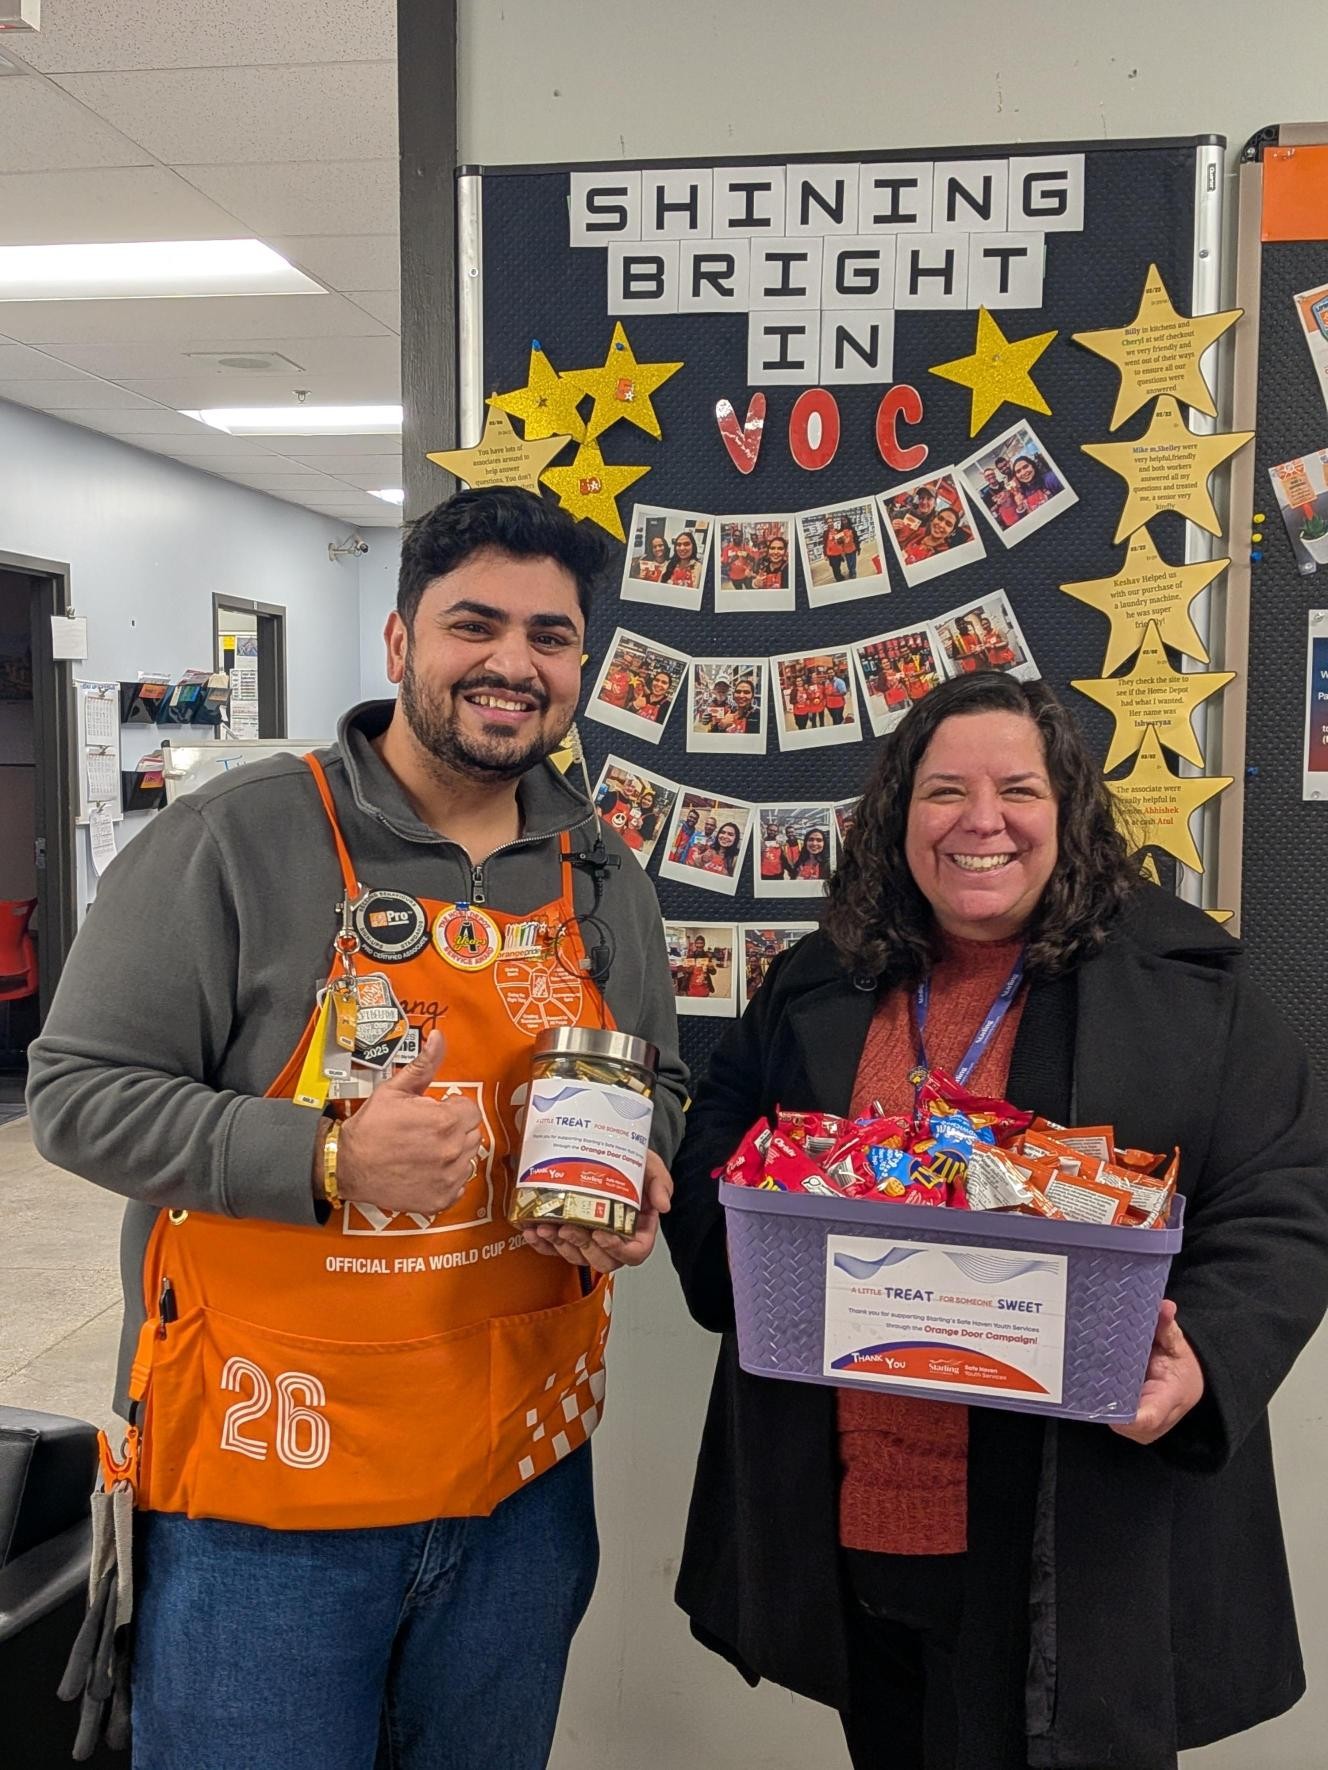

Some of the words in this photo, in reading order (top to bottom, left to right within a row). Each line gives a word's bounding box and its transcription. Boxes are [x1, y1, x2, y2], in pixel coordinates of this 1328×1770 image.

[586, 169, 1069, 233] SHINING
[621, 247, 1029, 301] BRIGHT
[1150, 324, 1177, 332] kitchens
[1122, 337, 1144, 347] Cheryl
[1154, 333, 1165, 342] self
[1166, 330, 1195, 340] checkout
[763, 323, 880, 370] IN
[1137, 348, 1151, 356] very
[1152, 343, 1178, 353] friendly
[1179, 341, 1191, 349] and
[1124, 358, 1140, 366] went
[1162, 353, 1177, 362] their
[1179, 352, 1195, 361] ways
[1142, 366, 1164, 375] ensure
[1165, 364, 1174, 372] all
[1137, 375, 1167, 386] questions
[1146, 384, 1177, 394] answered
[473, 458, 501, 466] associates
[503, 455, 523, 463] around
[1134, 456, 1148, 464] very
[485, 467, 498, 475] help
[1139, 465, 1150, 473] and
[1141, 474, 1170, 482] answered
[1180, 473, 1190, 481] my
[1133, 484, 1162, 493] questions
[1177, 492, 1191, 501] very
[1113, 579, 1140, 587] Keshav
[1142, 573, 1167, 583] Helped
[1110, 589, 1126, 598] with
[1128, 588, 1140, 596] our
[1141, 583, 1174, 595] purchase
[1175, 581, 1183, 589] of
[1120, 599, 1147, 609] laundry
[1149, 594, 1182, 604] machine,
[1126, 611, 1135, 619] he
[1136, 609, 1151, 617] was
[1152, 606, 1172, 616] super
[1169, 687, 1188, 695] Depot
[1143, 796, 1167, 804] helpful
[453, 935, 486, 951] Years
[444, 946, 473, 965] SERVICE
[363, 1044, 389, 1060] 2025
[556, 1116, 591, 1128] TREAT
[606, 1126, 630, 1137] SOMEONE
[580, 1145, 606, 1155] Orange
[607, 1150, 621, 1159] Door
[580, 1174, 603, 1184] Starling
[326, 1256, 390, 1274] OFFICIAL
[394, 1257, 426, 1273] FIFA
[429, 1248, 478, 1270] WORLD
[481, 1243, 506, 1260] CUP
[858, 1288, 882, 1296] LITTLE
[884, 1287, 934, 1302] TREAT
[939, 1295, 955, 1303] FOR
[957, 1296, 994, 1307] SOMEONE
[998, 1299, 1044, 1314] SWEET
[848, 1307, 867, 1315] Thank
[891, 1313, 925, 1321] supporting
[926, 1315, 956, 1323] Starling's
[1014, 1325, 1041, 1333] Services
[886, 1323, 911, 1331] through
[924, 1325, 960, 1336] Orange
[963, 1329, 985, 1338] Door
[987, 1332, 1039, 1345] Campaign!
[929, 1363, 960, 1375] Starling
[219, 1355, 331, 1470] 26
